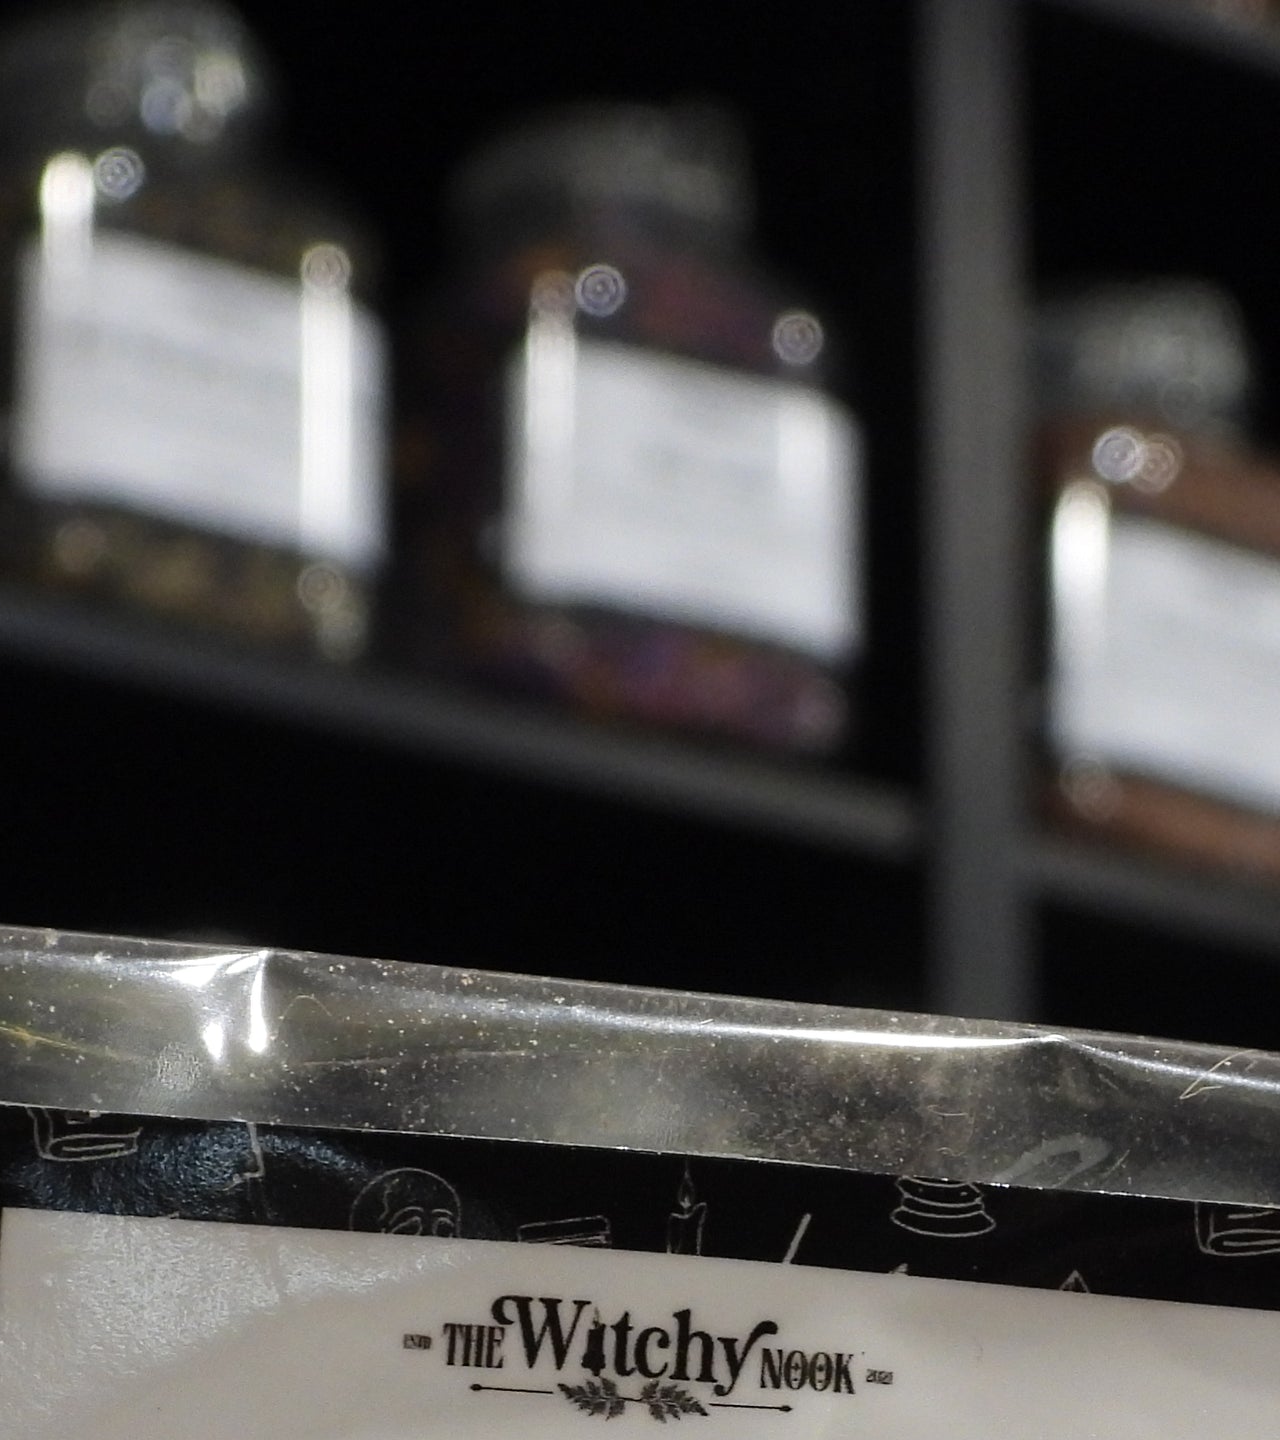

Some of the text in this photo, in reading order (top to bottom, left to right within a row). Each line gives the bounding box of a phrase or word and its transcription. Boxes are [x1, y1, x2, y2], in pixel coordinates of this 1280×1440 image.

[442, 1322, 505, 1369] THE
[490, 1294, 780, 1398] Witchy
[759, 1347, 856, 1395] NOOK
